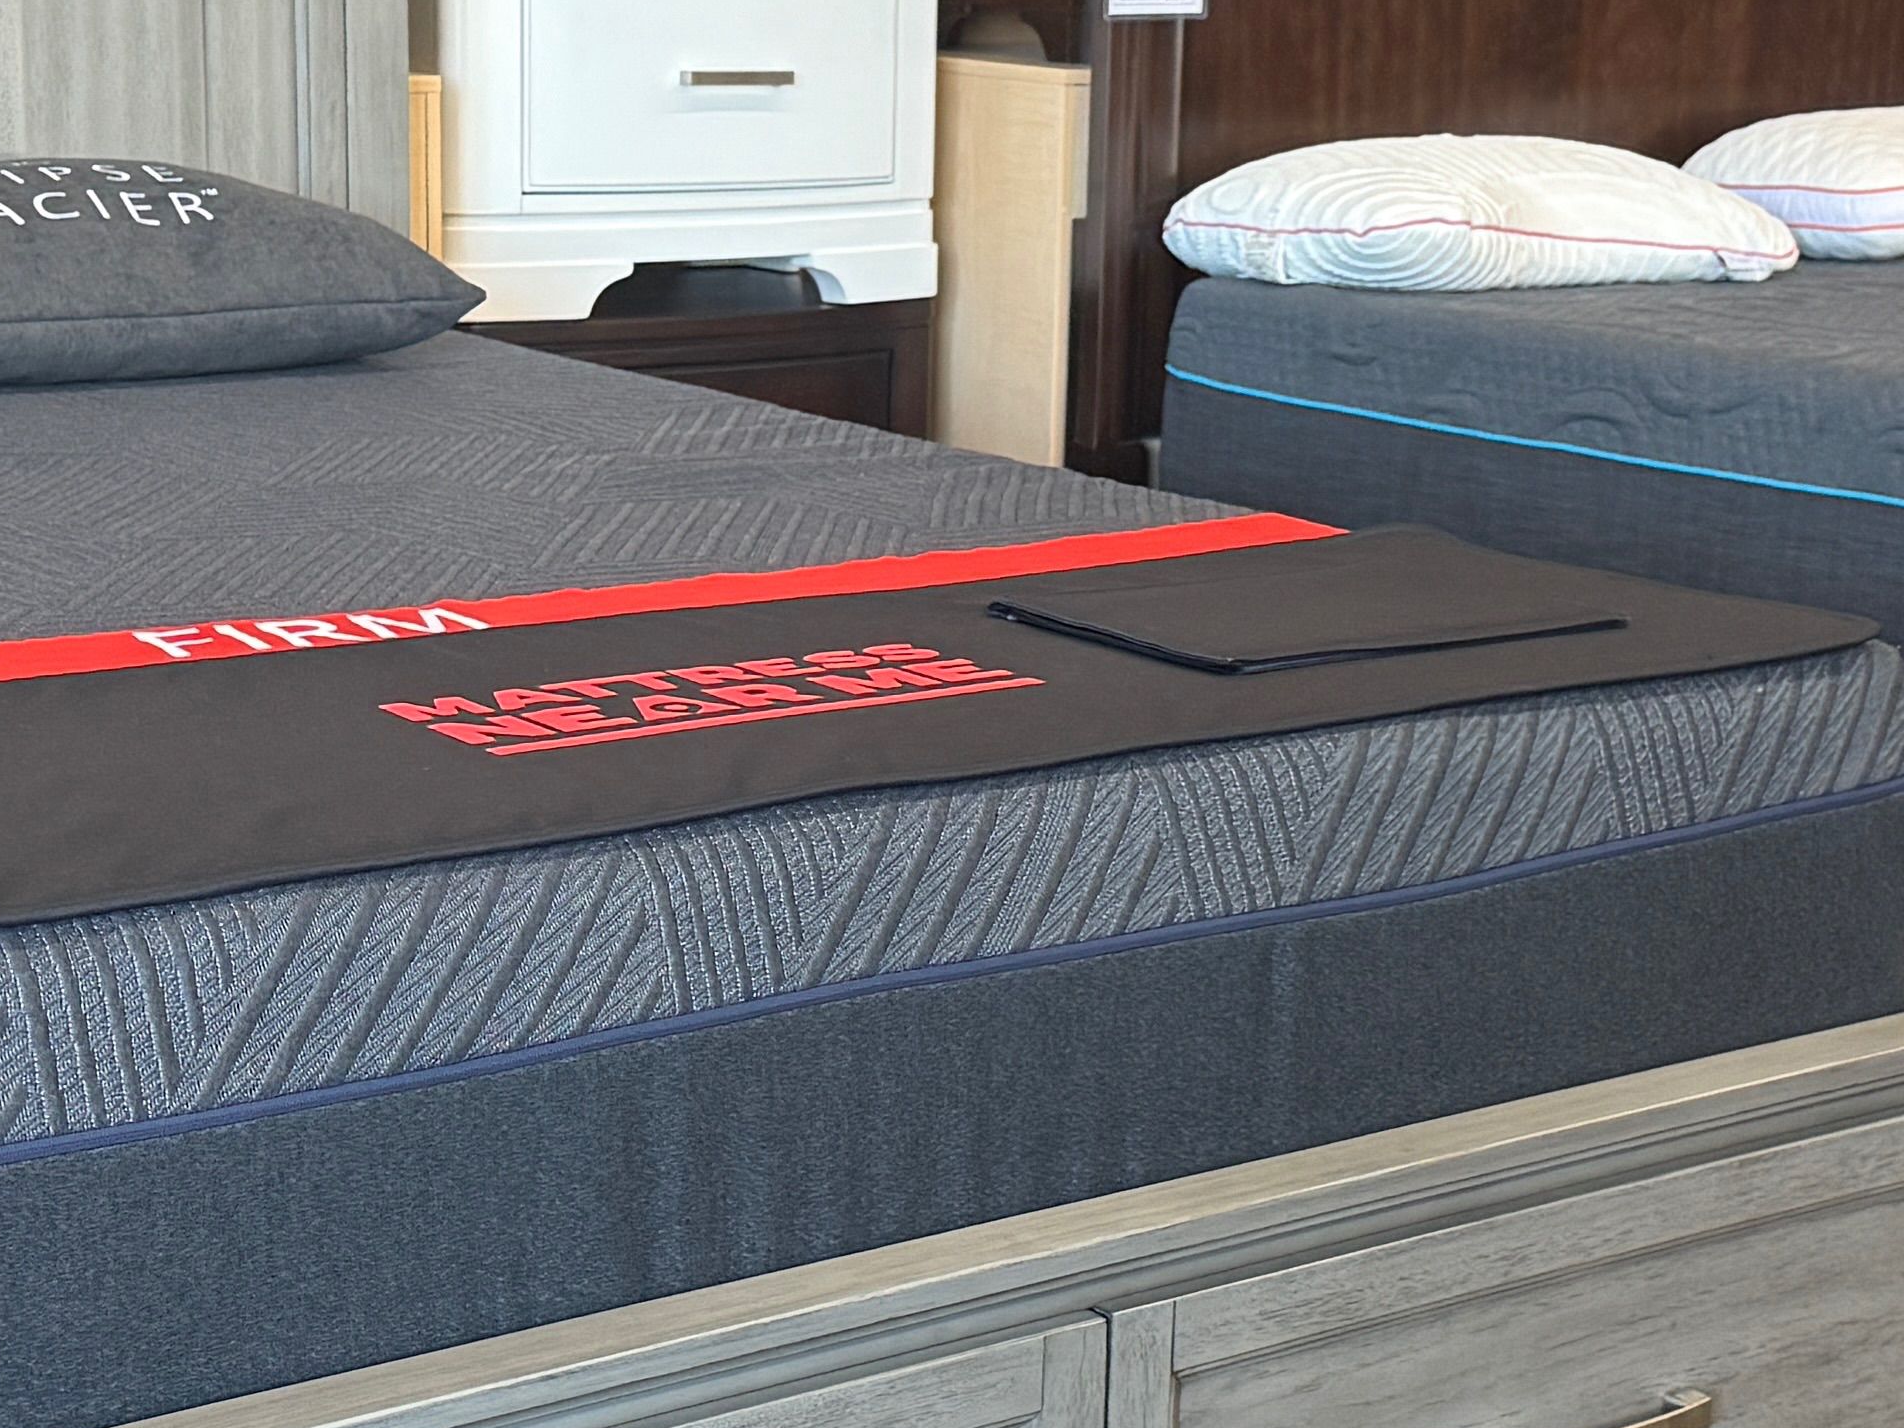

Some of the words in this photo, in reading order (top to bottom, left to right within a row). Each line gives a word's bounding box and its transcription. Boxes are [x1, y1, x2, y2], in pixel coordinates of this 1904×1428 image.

[133, 605, 490, 659] FIRM
[378, 642, 941, 723] MATTRESS
[425, 672, 806, 747] NEAR
[814, 657, 1012, 698] ME
